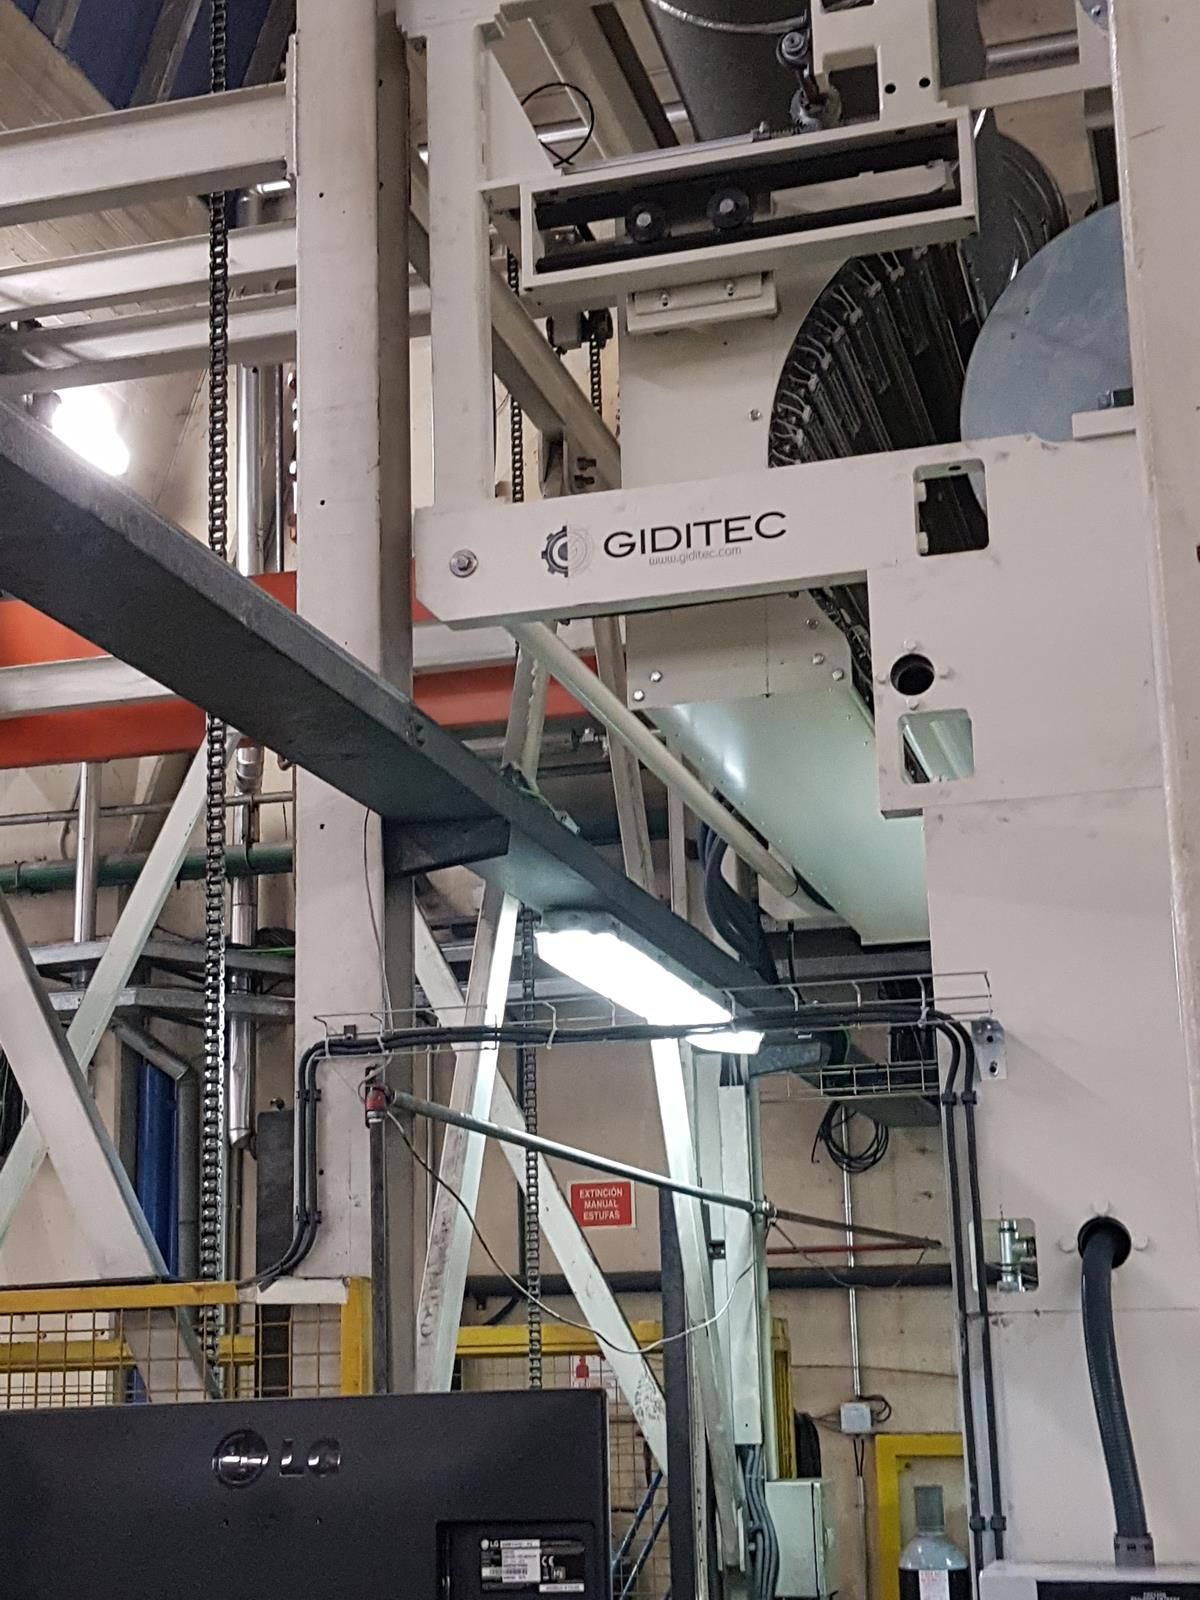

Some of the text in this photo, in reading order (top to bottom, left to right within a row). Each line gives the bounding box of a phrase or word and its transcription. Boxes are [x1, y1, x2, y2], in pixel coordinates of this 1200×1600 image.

[603, 511, 787, 559] GIDITEC
[648, 546, 742, 566] www.giditec.com
[579, 1187, 623, 1199] EXTINCIÓN
[584, 1199, 619, 1209] MANUAL
[583, 1210, 621, 1221] ESTUFAS
[280, 1438, 342, 1478] LG
[490, 1540, 499, 1548] LG
